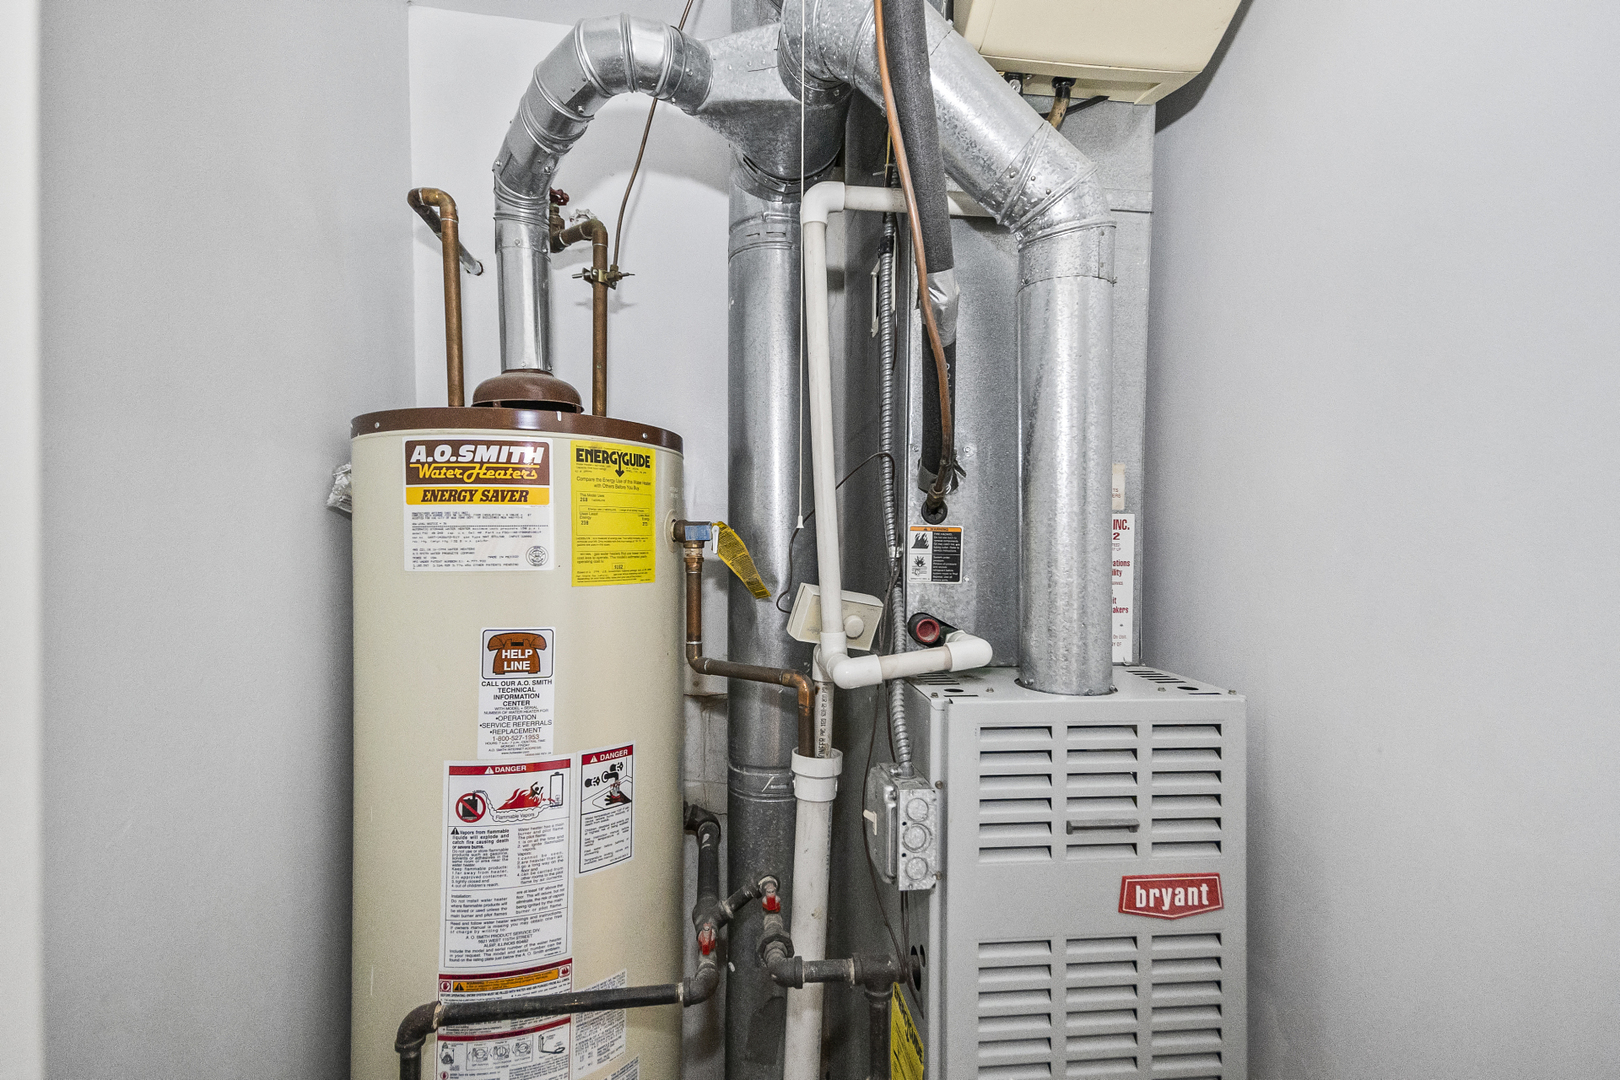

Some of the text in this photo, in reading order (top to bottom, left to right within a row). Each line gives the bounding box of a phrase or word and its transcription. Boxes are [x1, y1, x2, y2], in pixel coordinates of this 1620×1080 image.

[410, 445, 544, 463] A.O.SMITH
[576, 448, 650, 468] ENERGYGUIDE
[420, 464, 538, 482] Water Heaters
[421, 489, 529, 502] ENERGY SAVER
[1113, 519, 1130, 530] INC.
[1113, 532, 1120, 540] 2
[502, 650, 533, 658] HELP
[504, 661, 530, 670] LINE
[600, 749, 628, 761] DANGER
[1136, 884, 1209, 910] bryant
